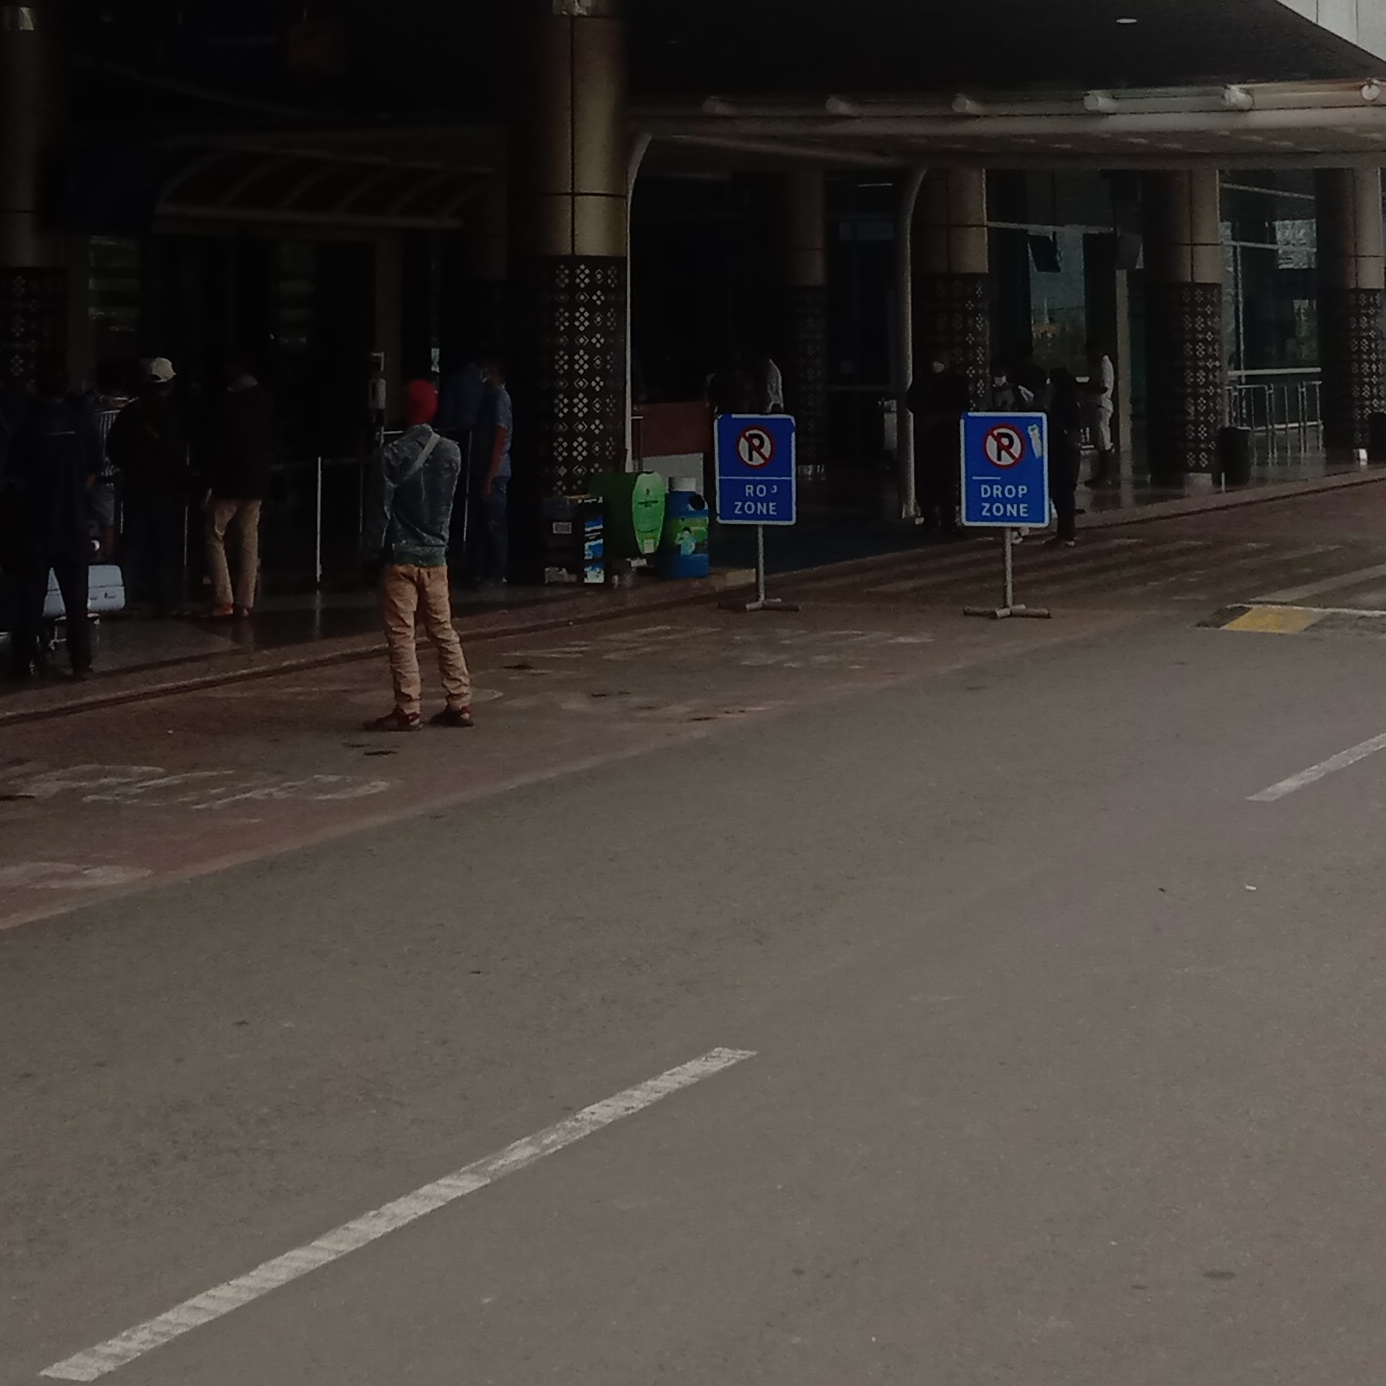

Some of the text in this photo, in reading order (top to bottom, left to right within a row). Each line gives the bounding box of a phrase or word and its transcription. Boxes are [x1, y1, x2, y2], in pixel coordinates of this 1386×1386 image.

[980, 484, 1028, 499] DROP
[733, 500, 778, 515] ZONE
[981, 502, 1030, 517] ZONE
